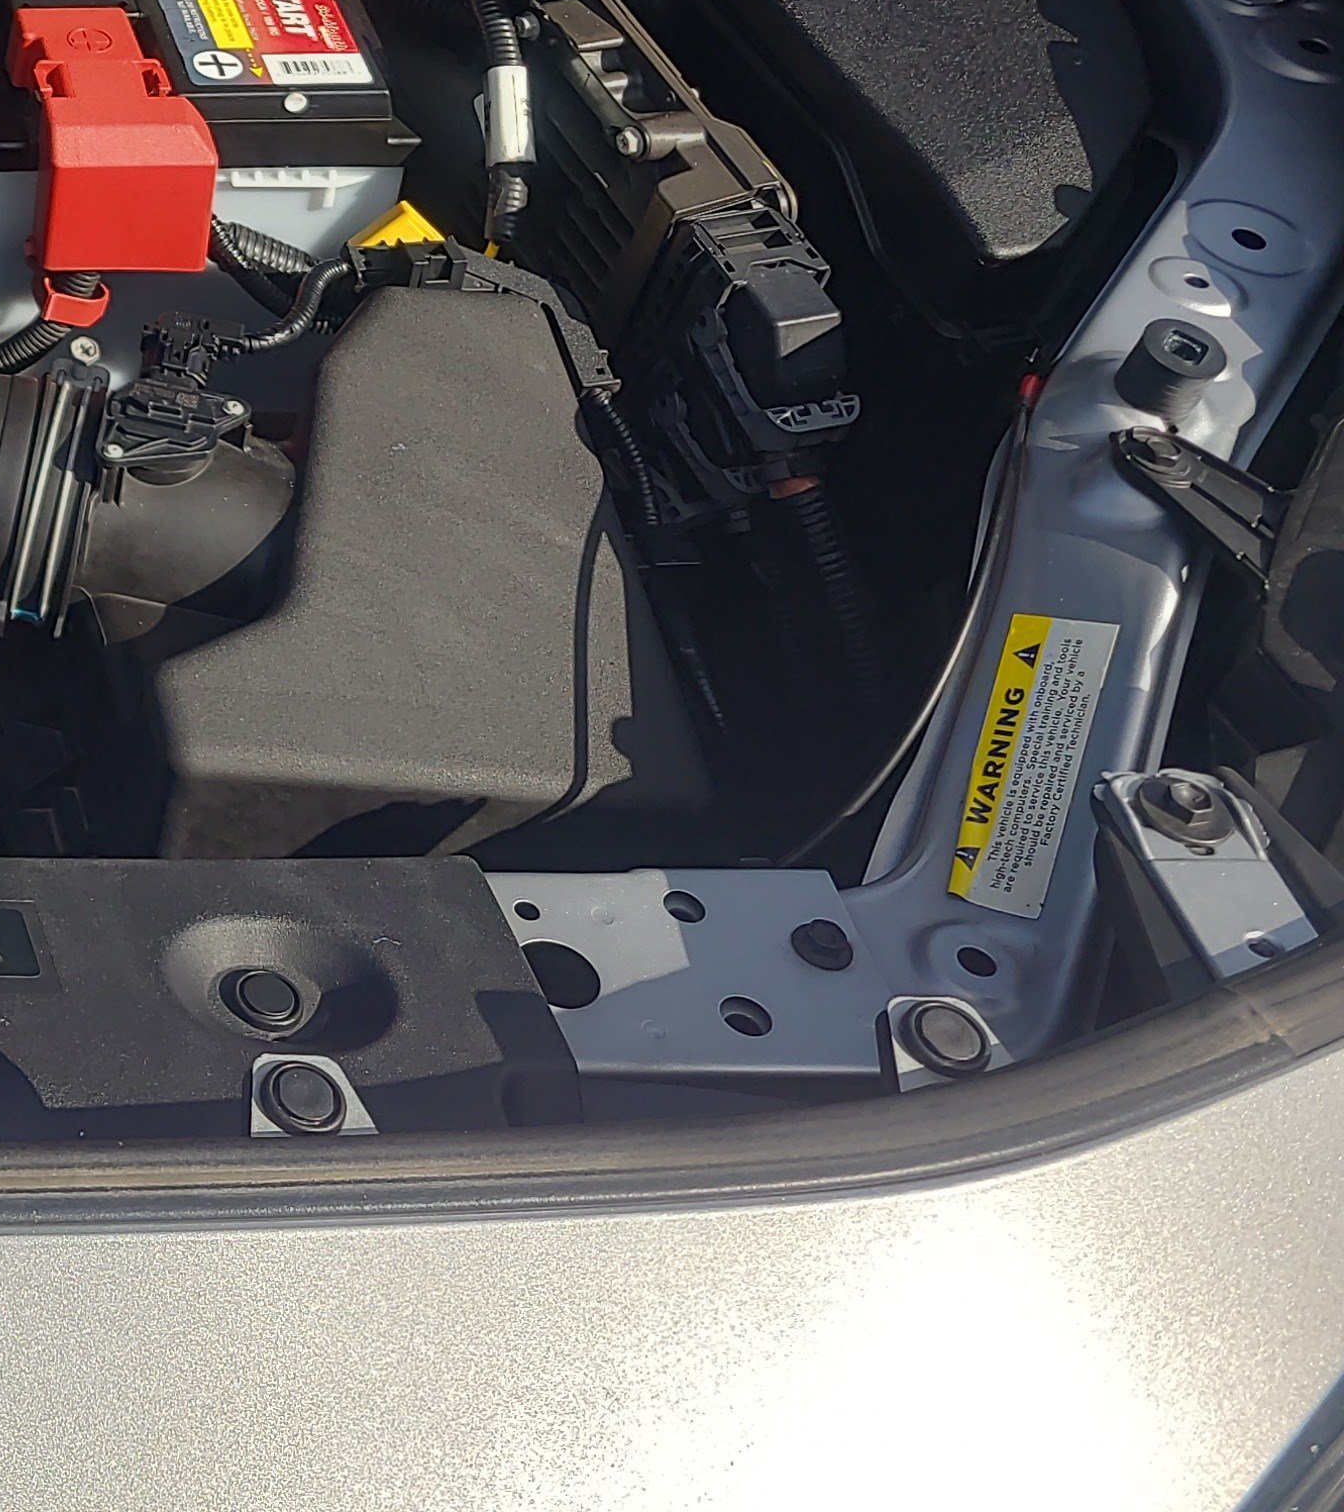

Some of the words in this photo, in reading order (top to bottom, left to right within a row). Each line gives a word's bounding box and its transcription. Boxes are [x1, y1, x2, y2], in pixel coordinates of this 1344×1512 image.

[1056, 638, 1072, 664] tools
[1065, 638, 1083, 675] vehicle
[1050, 665, 1063, 686] and
[1055, 677, 1071, 701] Your
[1070, 678, 1083, 693] by
[1037, 688, 1058, 729] training
[1044, 707, 1064, 747] vehicle.
[1058, 694, 1078, 739] serviced
[965, 687, 1024, 824] WARNING
[986, 840, 1002, 861] This
[996, 800, 1014, 838] vehicle
[1011, 735, 1032, 786] equipped
[1025, 709, 1039, 733] with
[1033, 661, 1055, 708] onboard,
[1025, 731, 1045, 770] Special
[1037, 749, 1051, 769] this
[1039, 803, 1060, 846] Factory
[1051, 753, 1073, 801] Certified
[1065, 693, 1091, 750] Technician.
[1052, 741, 1065, 763] and
[1008, 776, 1032, 836] computers.
[1027, 771, 1045, 810] service
[1039, 764, 1060, 810] repaired
[1022, 812, 1033, 825] to
[1032, 812, 1045, 827] be
[989, 838, 1015, 889] high-tech
[1009, 826, 1030, 873] required
[1023, 829, 1041, 867] should
[1002, 875, 1015, 893] are
